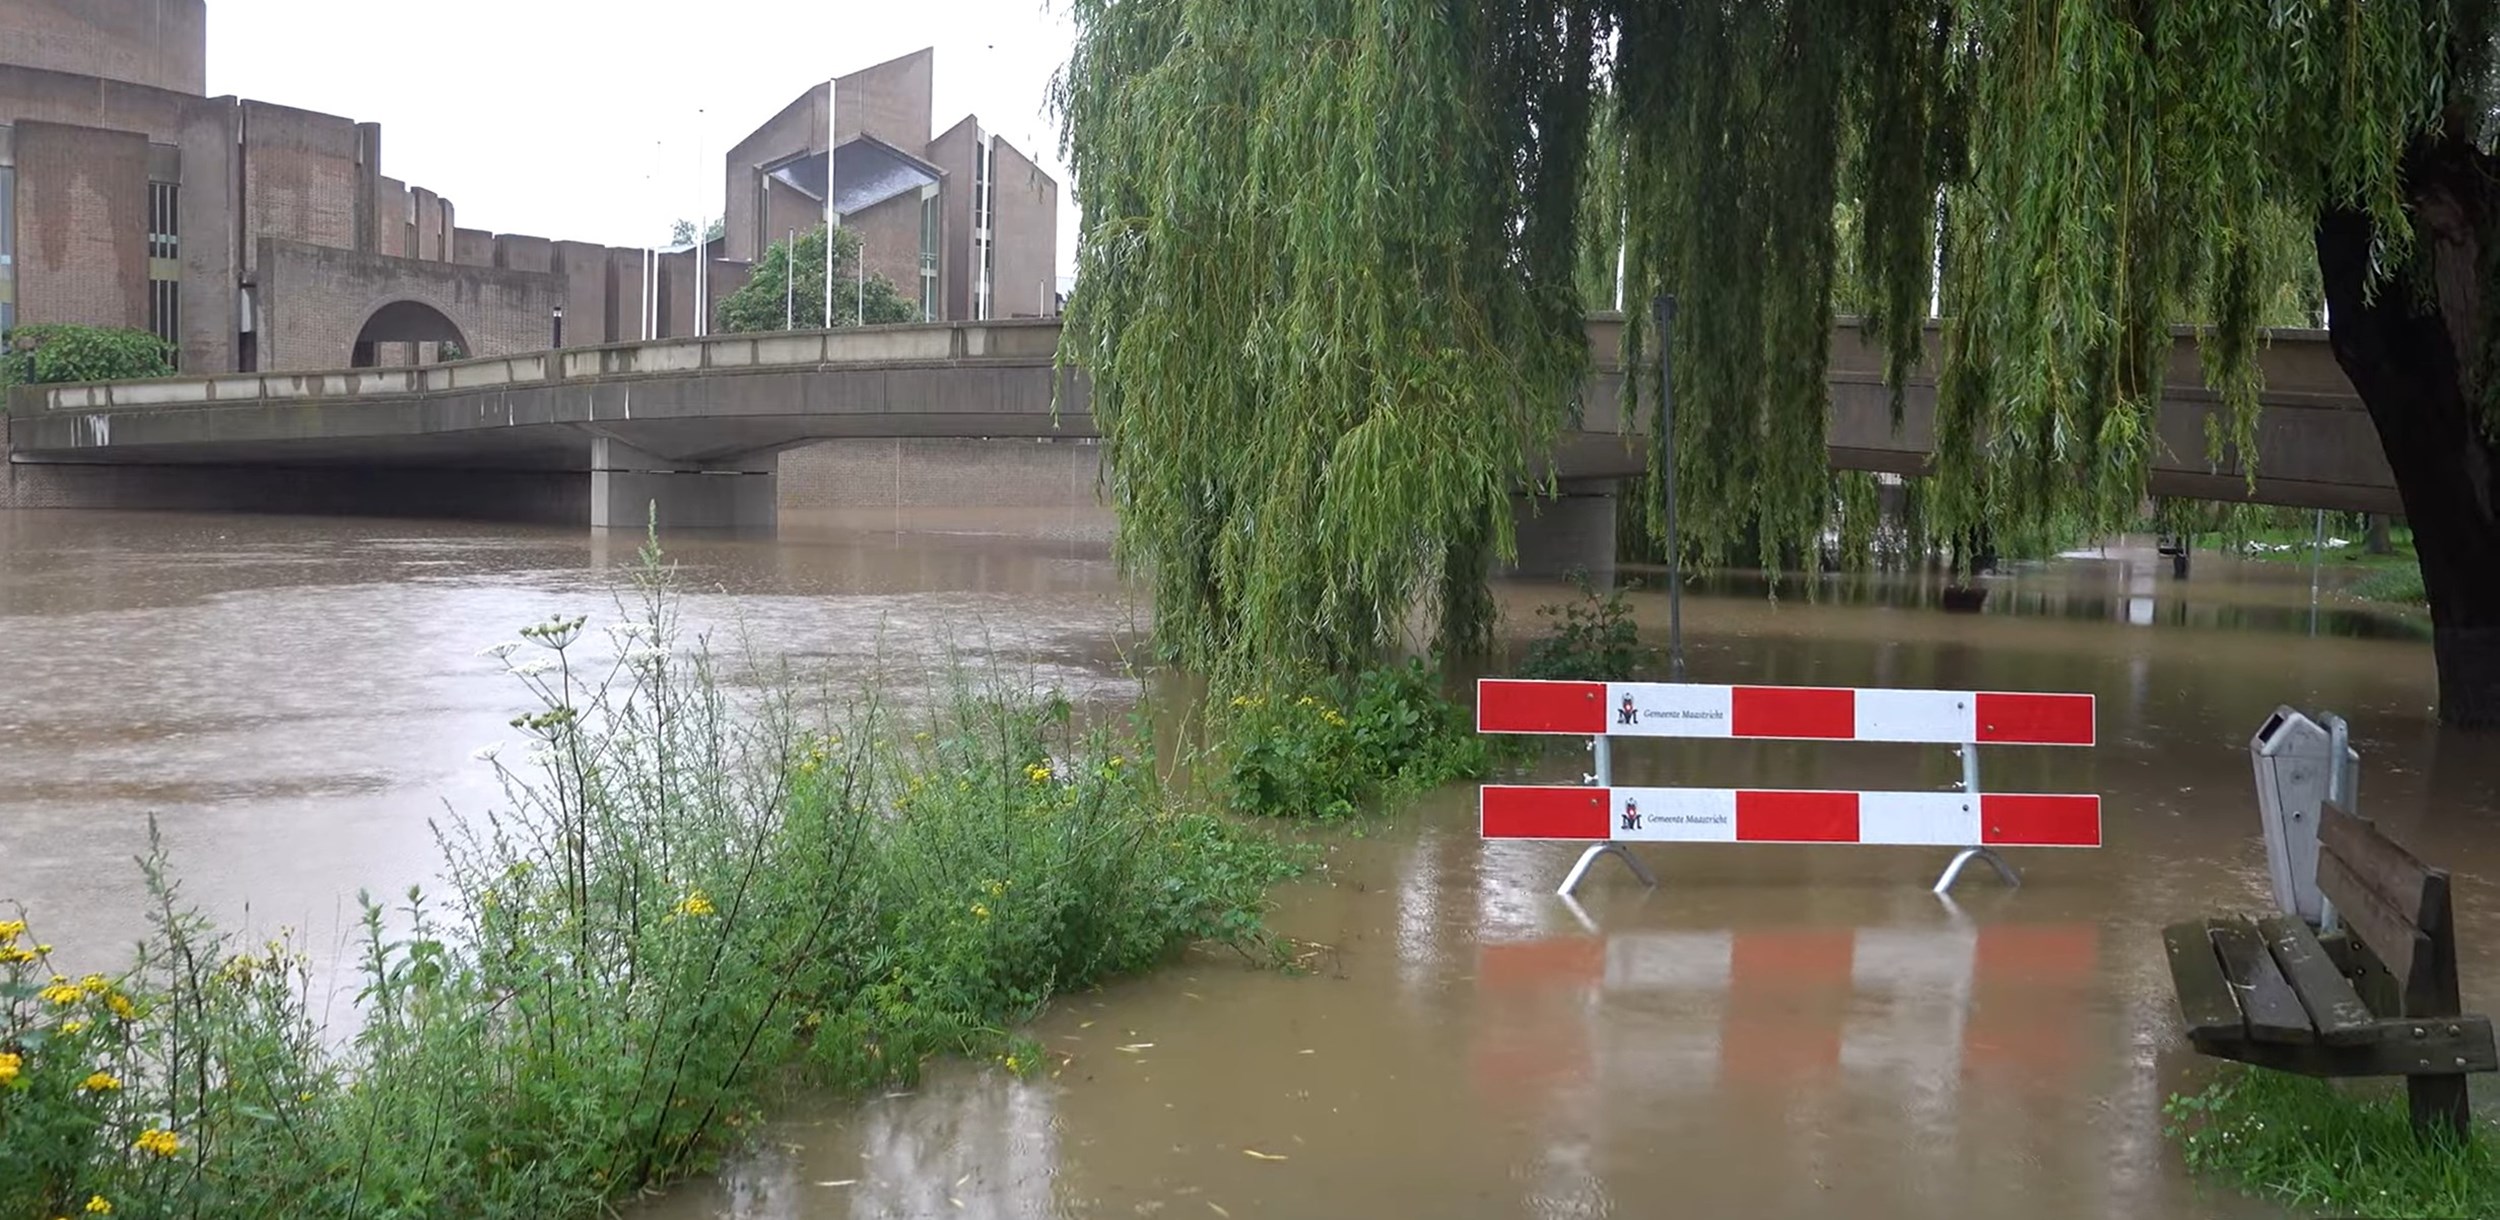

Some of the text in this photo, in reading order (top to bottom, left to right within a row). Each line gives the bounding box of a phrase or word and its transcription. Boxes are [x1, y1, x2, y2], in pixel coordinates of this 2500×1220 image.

[1643, 709, 1723, 720] Gemeente Maastricht
[1648, 814, 1727, 824] Gemeente Maastricht
